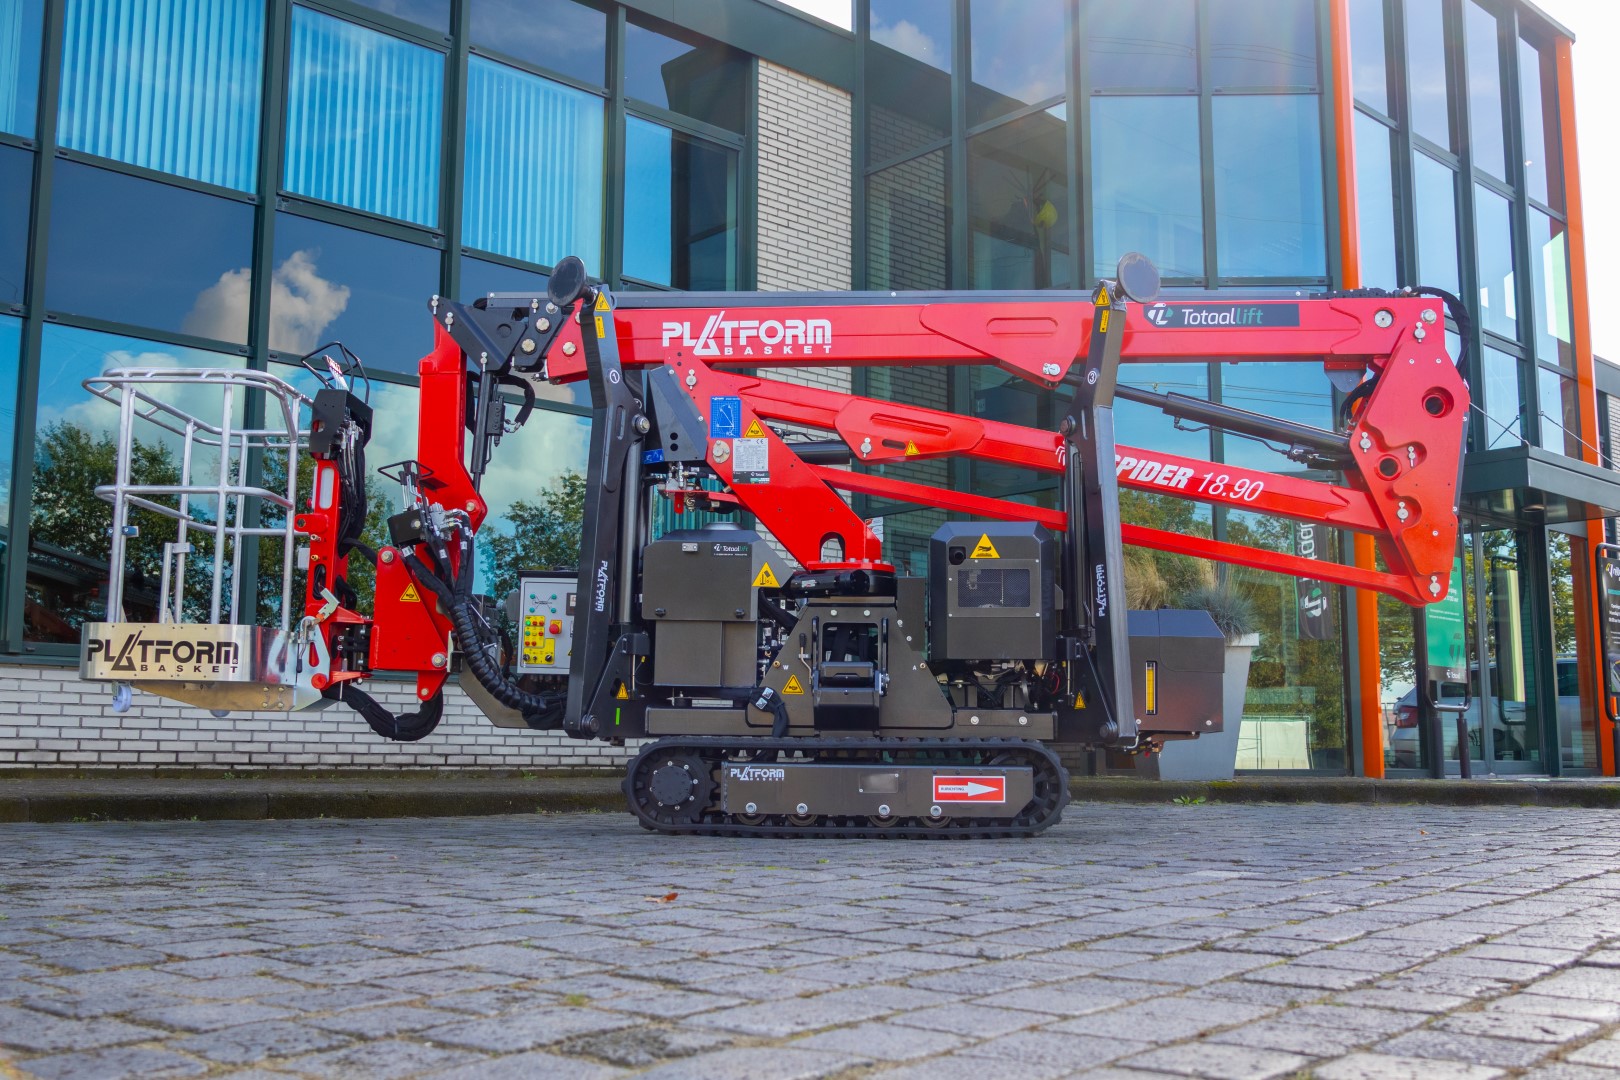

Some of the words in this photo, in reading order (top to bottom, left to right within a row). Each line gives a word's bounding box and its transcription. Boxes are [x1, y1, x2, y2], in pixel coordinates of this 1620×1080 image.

[1182, 308, 1264, 325] Totaallift
[662, 311, 832, 356] PLATFORM
[724, 345, 832, 355] BASKET
[1198, 472, 1264, 501] 18.90
[596, 560, 608, 612] PLATFORM
[1096, 564, 1107, 617] PLATFORM
[88, 630, 239, 671] PLATFORM
[140, 664, 238, 673] BASKET
[730, 765, 785, 781] PLATFORM
